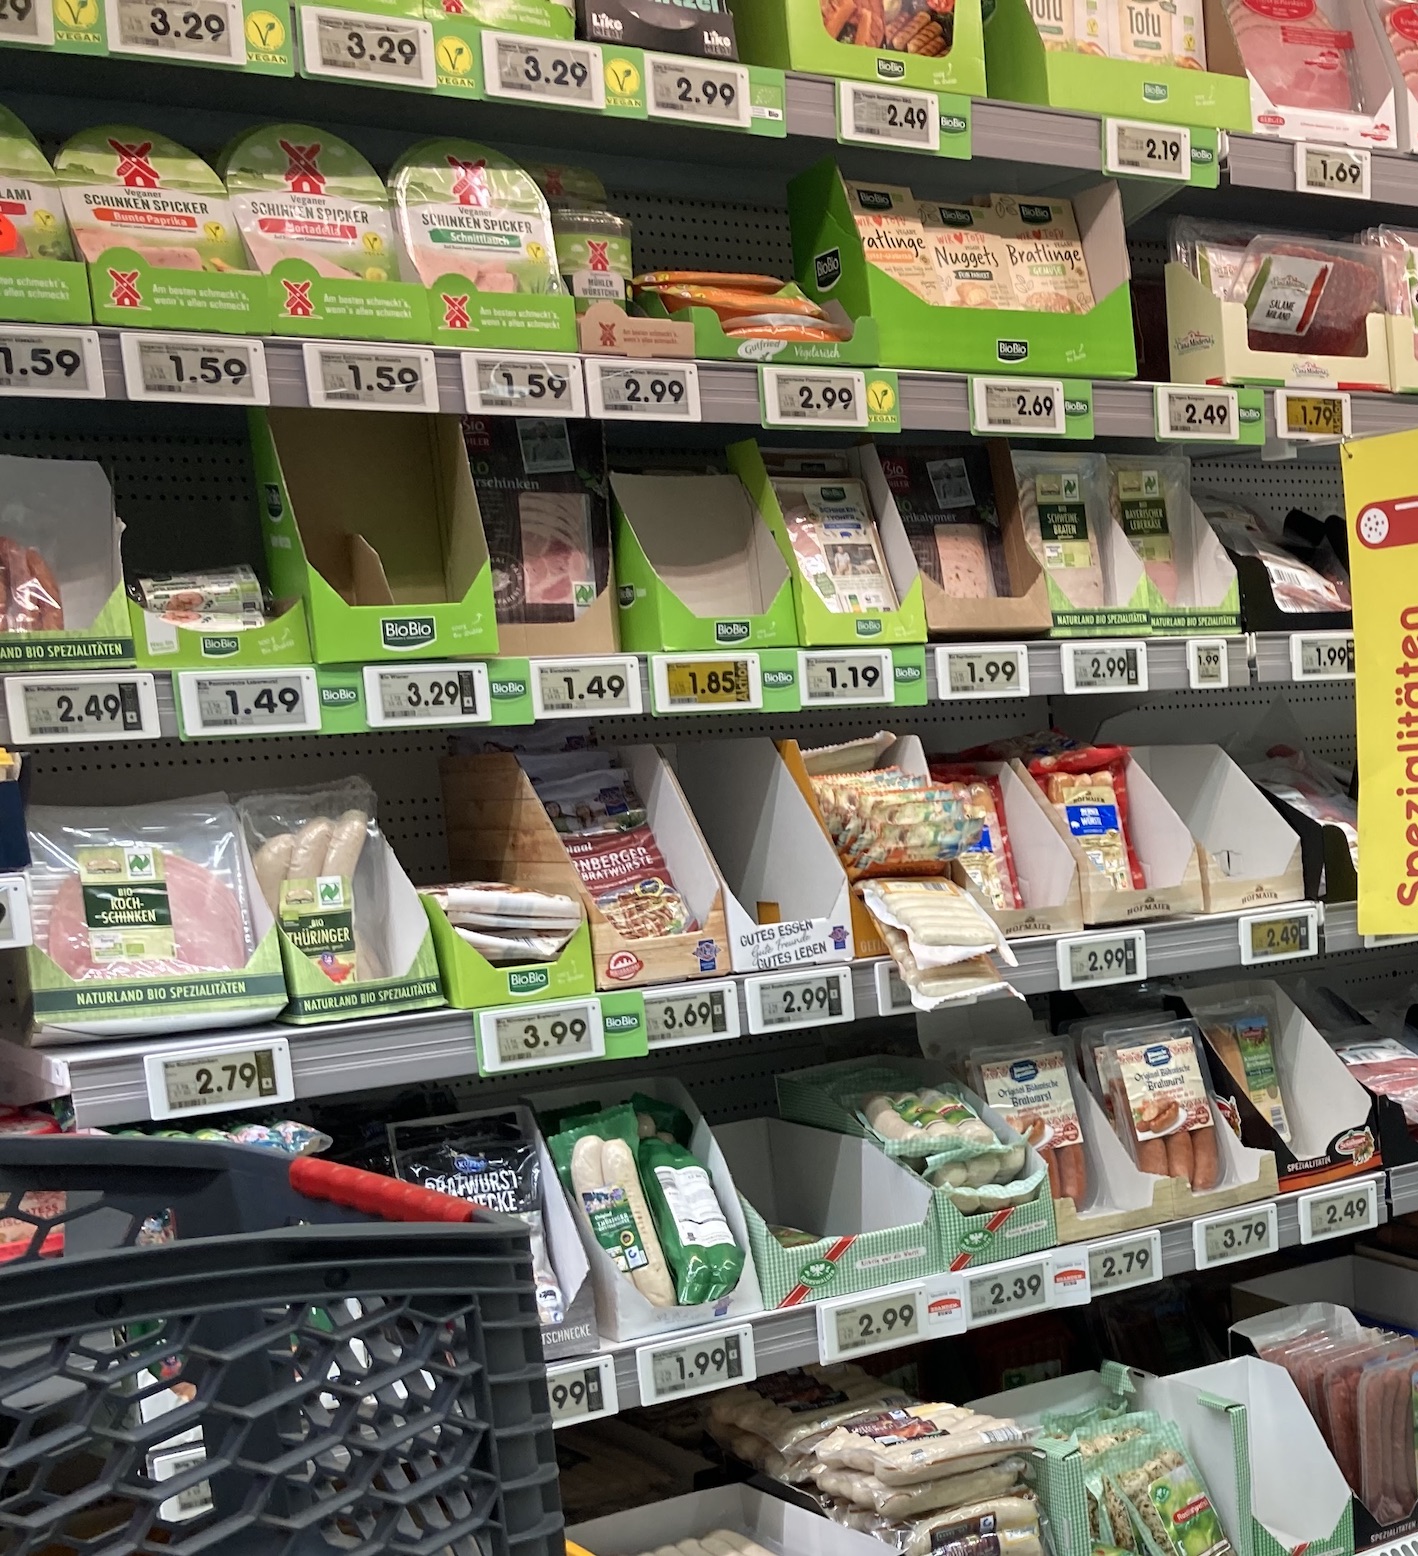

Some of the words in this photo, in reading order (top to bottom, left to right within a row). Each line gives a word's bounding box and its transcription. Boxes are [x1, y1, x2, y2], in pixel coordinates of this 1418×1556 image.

[150, 8, 226, 42] 3.29
[1129, 7, 1162, 38] Tofu
[56, 32, 101, 43] VEGAN
[246, 52, 288, 65] VEGAN
[347, 32, 418, 66] 3.29
[438, 76, 475, 89] VEGAN
[525, 56, 588, 88] 3.29
[606, 99, 641, 107] VEGAN
[677, 77, 735, 109] 2.99
[887, 105, 927, 131] 2.49
[940, 117, 966, 129] BioBio
[1147, 139, 1180, 163] 2.19
[1320, 159, 1361, 184] 1.69
[84, 193, 150, 211] SCHINKEN
[153, 200, 209, 214] SPICKER
[251, 202, 313, 219] SCHINKEN
[318, 208, 369, 224] SPICKER
[422, 213, 480, 230] SCHINKEN
[484, 217, 533, 233] SPICKER
[935, 245, 999, 268] Nuggets
[1006, 244, 1081, 270] Bratlinge
[153, 284, 166, 294] Am
[999, 342, 1026, 357] BioBio
[0, 347, 81, 377] 1.59
[170, 355, 247, 385] 1.59
[349, 364, 419, 393] 1.59
[625, 377, 684, 403] 2.99
[799, 386, 852, 411] 2.99
[1016, 395, 1053, 417] 2.69
[1065, 402, 1088, 412] BioBio
[1185, 404, 1227, 424] 2.49
[1301, 406, 1332, 426] 1.79
[868, 415, 896, 423] VEGAN
[1053, 523, 1077, 536] BRATEN
[1057, 616, 1093, 626] NATURLAND
[1095, 614, 1107, 624] BIO
[1109, 612, 1147, 624] SPEZIALITÄTEN
[1151, 617, 1185, 628] NATURLAND
[1187, 616, 1196, 626] BIO
[1199, 614, 1236, 626] SPEZIALITÄTEN
[385, 622, 432, 640] BioBio
[717, 625, 748, 638] BioBio
[205, 638, 237, 652] BioBio
[1091, 659, 1127, 678] 2.99
[1199, 655, 1218, 666] 1.99
[1316, 648, 1347, 667] 1.99
[689, 670, 735, 694] 1.85
[765, 672, 793, 683] BioBio
[827, 665, 880, 688] 1.19
[895, 667, 919, 678] BioBio
[967, 661, 1016, 683] 1.99
[322, 688, 356, 701] BioBio
[408, 680, 459, 708] 3.29
[492, 682, 525, 694] BioBio
[564, 674, 625, 700] 1.49
[57, 694, 121, 722] 2.49
[226, 688, 300, 715] 1.49
[1127, 904, 1171, 916] HOFMAIER
[1006, 921, 1051, 933] HOFMAIER
[1267, 929, 1298, 952] 2.49
[757, 952, 792, 970] GUTES
[795, 942, 827, 962] LEBEN
[1088, 948, 1124, 972] 2.99
[511, 971, 546, 986] BioBio
[77, 989, 144, 1005] NATURLAND
[147, 987, 165, 1001] BIO
[170, 981, 246, 998] SPEZIALITÄTEN
[304, 994, 357, 1012] NATURLAND
[361, 991, 375, 1005] BIO
[378, 982, 437, 1003] SPEZIALITÄTEN
[783, 987, 827, 1014] 2.99
[606, 1015, 638, 1029] BioBio
[664, 1002, 711, 1029] 3.69
[524, 1018, 586, 1049] 3.99
[196, 1063, 256, 1095] 2.79
[1012, 1092, 1051, 1107] Bratwurst
[1327, 1199, 1367, 1224] 2.49
[1223, 1222, 1267, 1248] 3.79
[1102, 1249, 1150, 1277] 2.79
[991, 1274, 1042, 1304] 2.39
[859, 1305, 914, 1336] 2.99
[541, 1324, 591, 1345] TSCHNECKE
[676, 1349, 725, 1380] 1.99
[1371, 1521, 1416, 1542] SPEZIALITÄTEN
